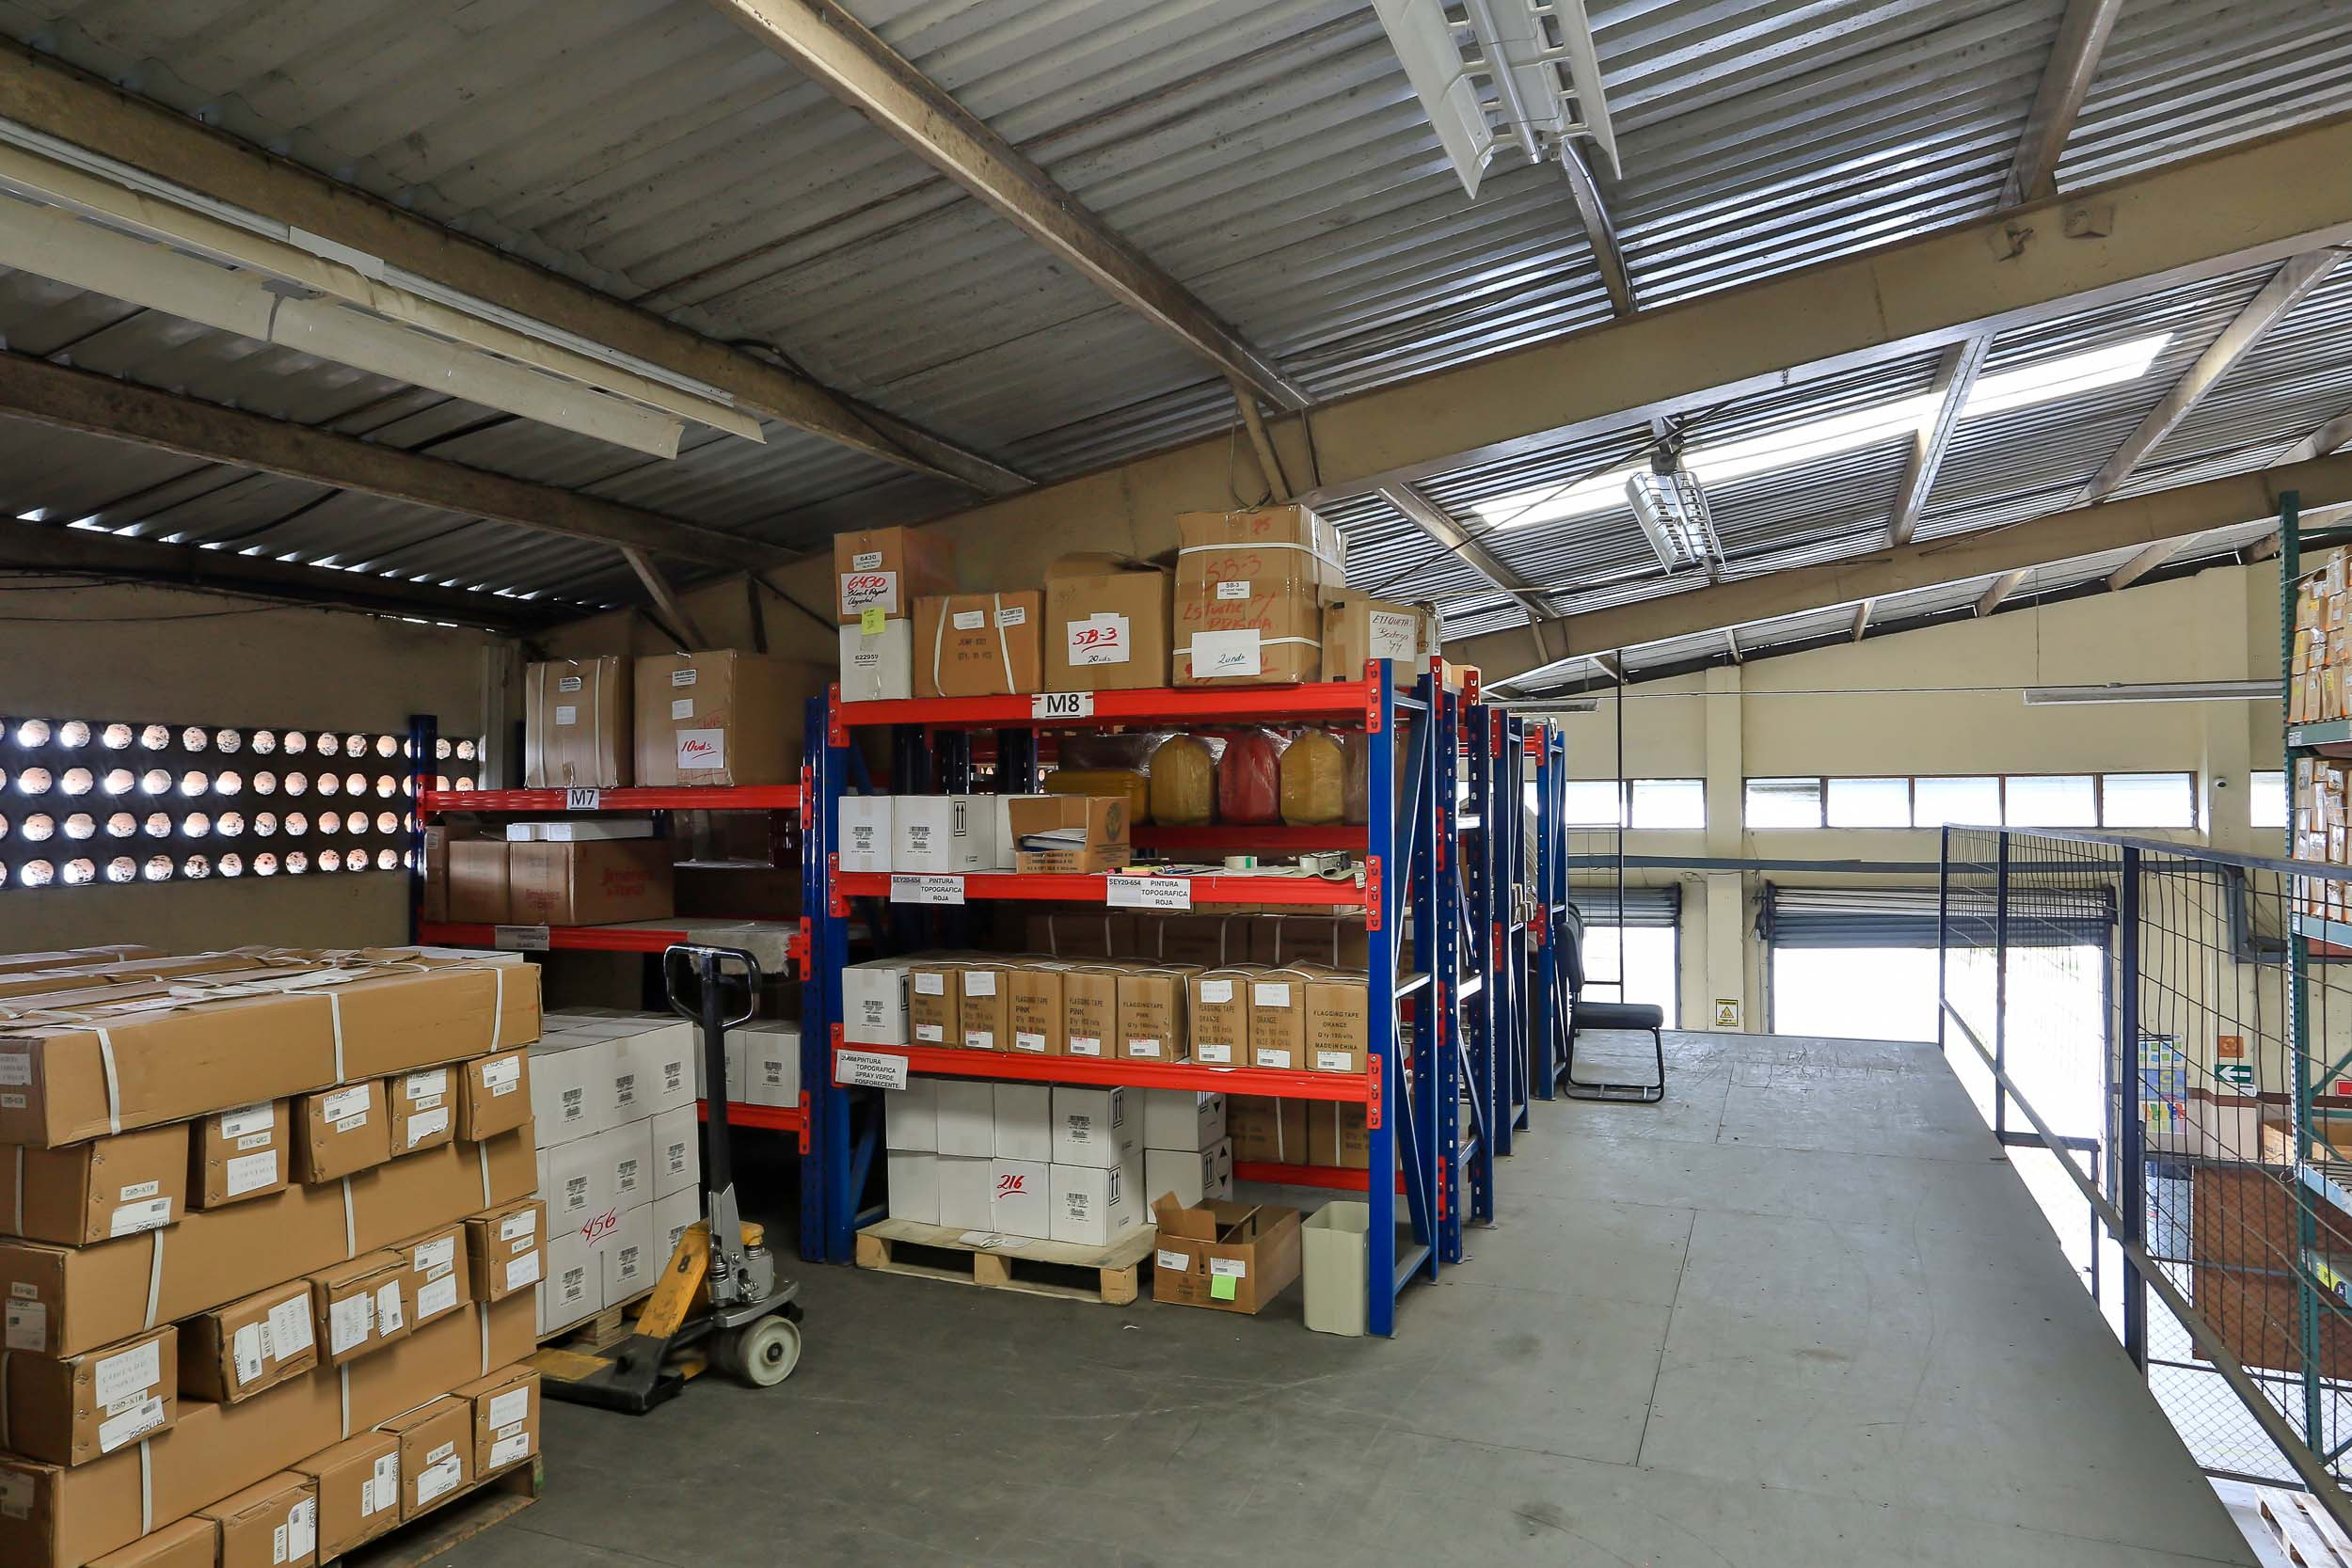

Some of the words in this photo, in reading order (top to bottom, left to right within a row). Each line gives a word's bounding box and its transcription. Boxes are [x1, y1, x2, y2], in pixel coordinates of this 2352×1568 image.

[848, 576, 886, 591] 6430
[1073, 626, 1117, 645] SB-3
[1046, 693, 1080, 713] M8
[571, 789, 595, 806] M7
[1141, 889, 1188, 897] TOPOGRAFICA
[856, 1064, 896, 1073] TOPOGRAFICA
[854, 1078, 900, 1089] FOSFORECENTE
[876, 1073, 894, 1082] VERDE
[996, 1174, 1025, 1189] 216
[580, 1207, 617, 1243] 456
